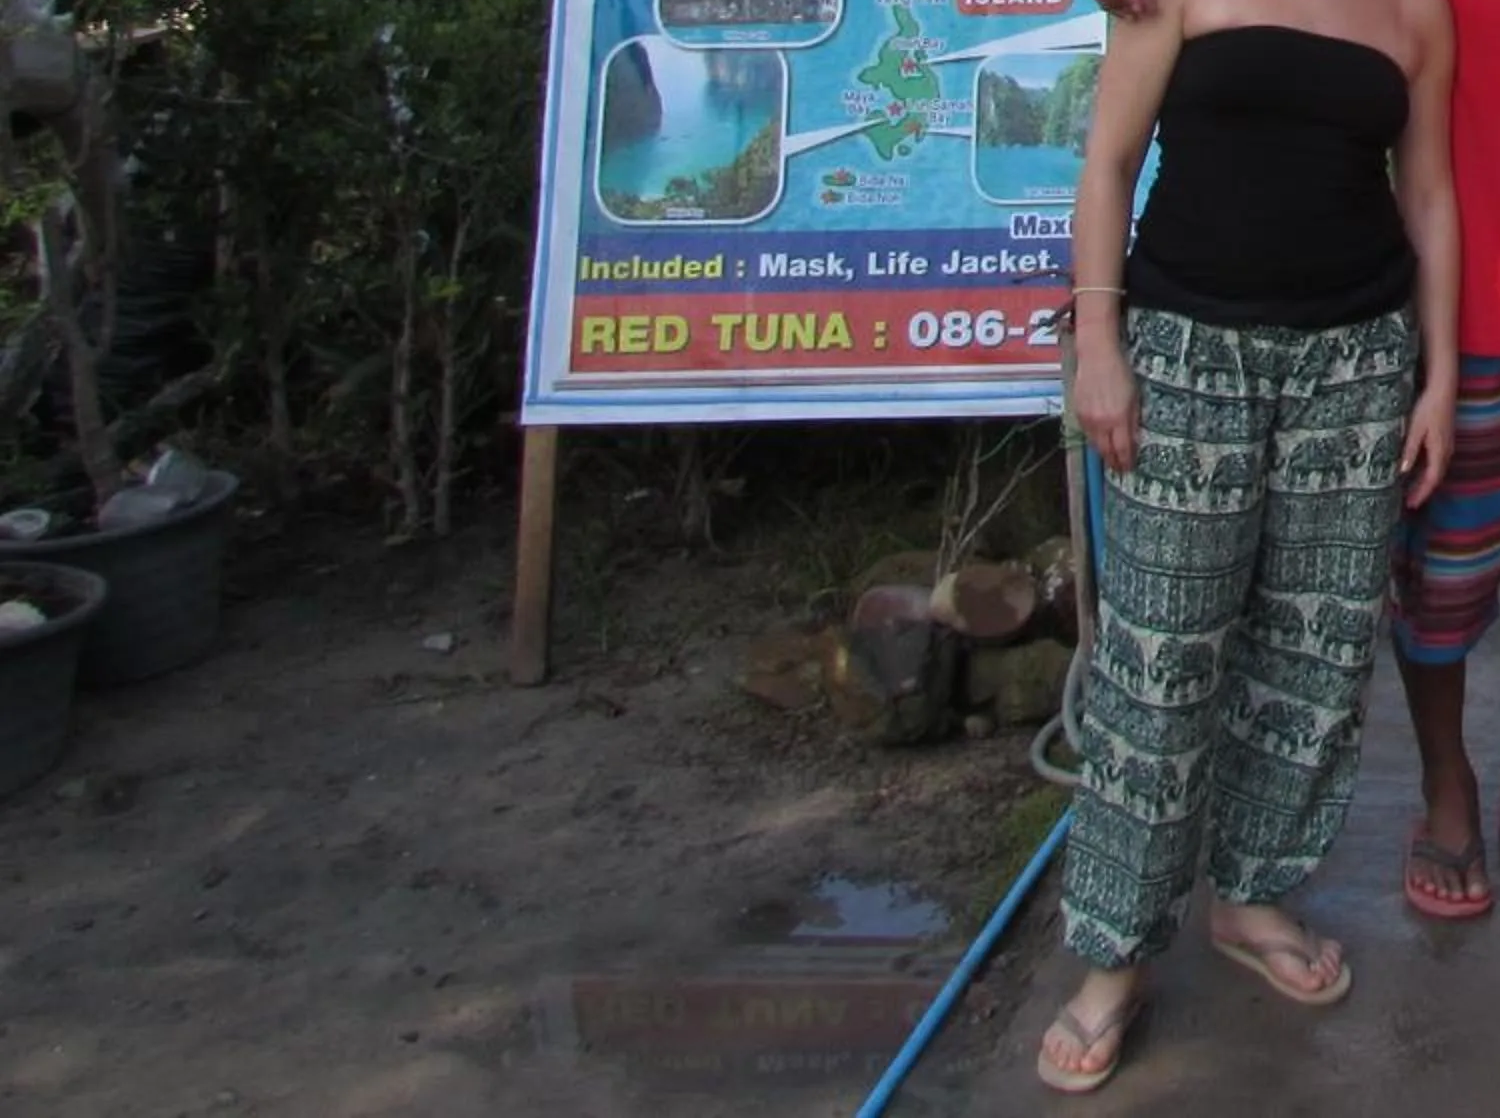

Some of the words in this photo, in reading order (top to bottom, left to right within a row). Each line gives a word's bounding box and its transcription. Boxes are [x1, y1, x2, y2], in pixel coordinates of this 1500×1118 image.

[580, 254, 723, 282] Included
[759, 252, 854, 281] Mask,
[867, 250, 929, 277] Life
[581, 315, 690, 354] RED
[712, 312, 853, 352] TUNA
